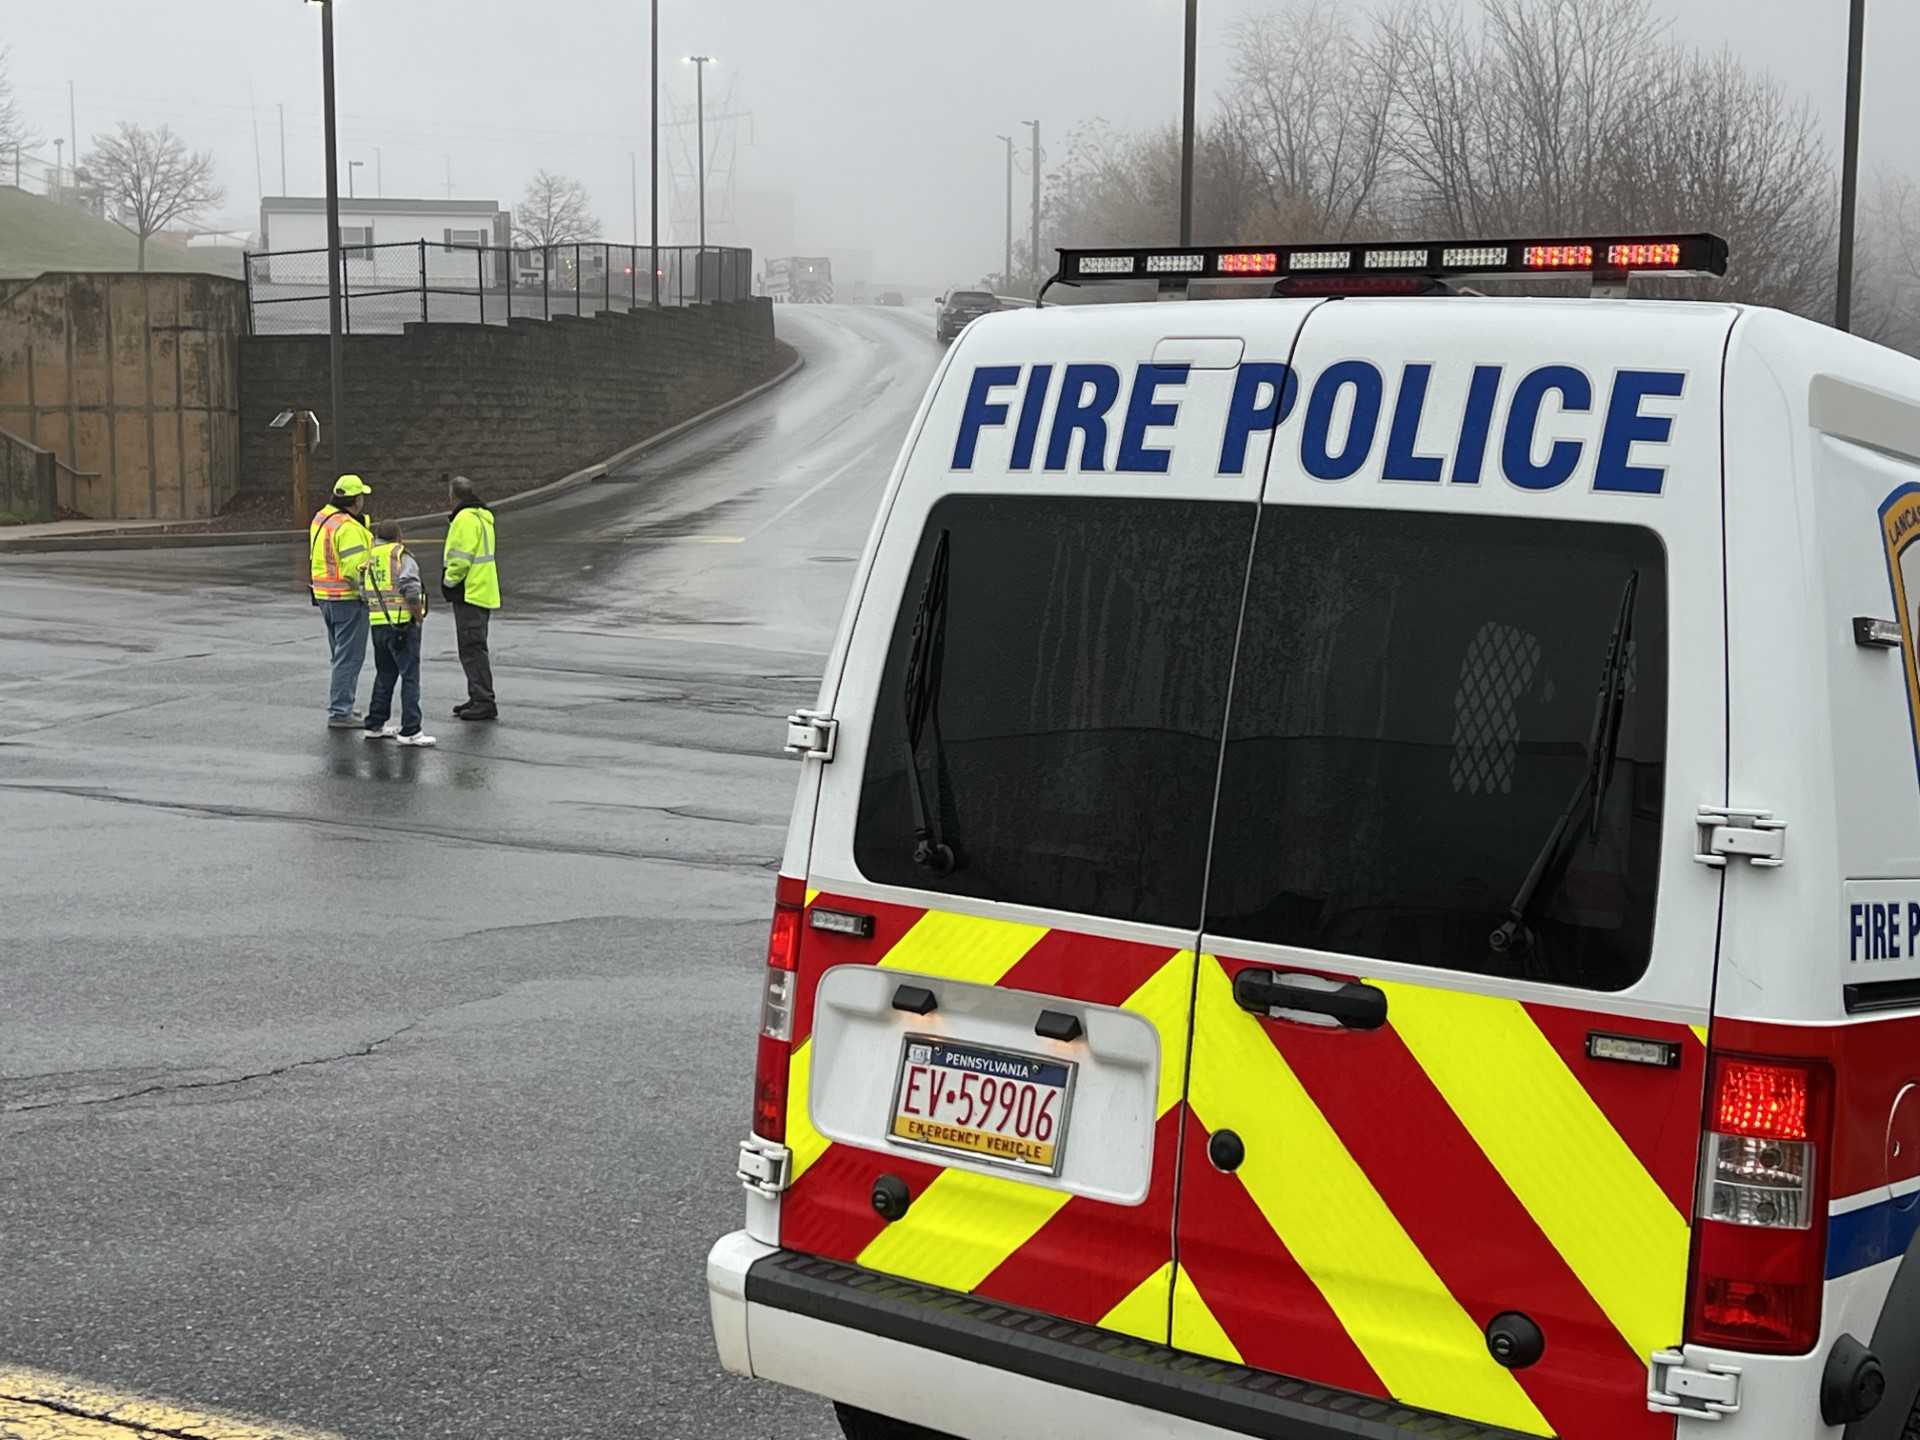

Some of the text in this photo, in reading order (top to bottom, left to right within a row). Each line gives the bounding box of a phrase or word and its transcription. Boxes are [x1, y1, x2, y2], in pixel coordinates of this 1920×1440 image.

[949, 360, 1687, 496] FIRE POLICE
[1850, 902, 1900, 961] FIRE
[946, 1052, 1029, 1078] PENNSYLVANIA
[908, 1120, 1042, 1159] EMERGENCY VEHICLE
